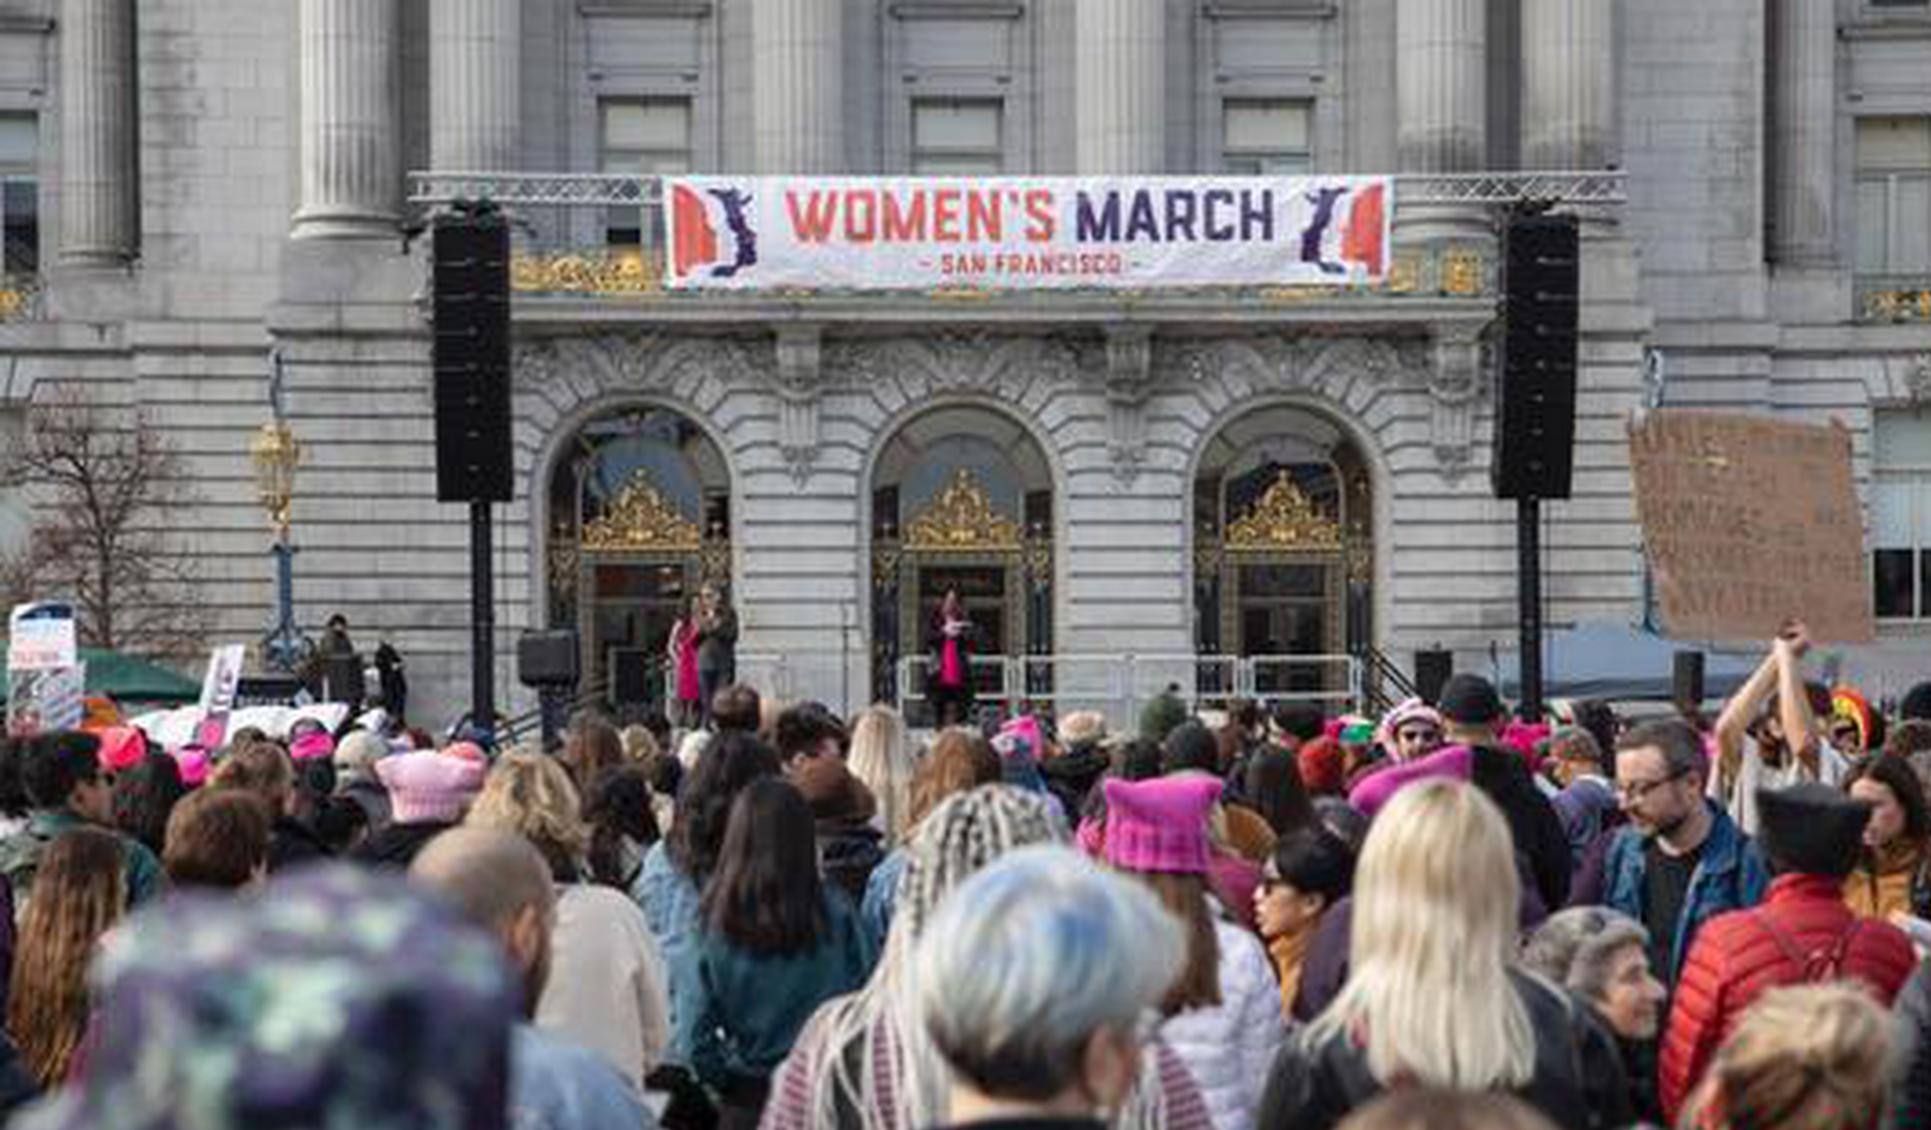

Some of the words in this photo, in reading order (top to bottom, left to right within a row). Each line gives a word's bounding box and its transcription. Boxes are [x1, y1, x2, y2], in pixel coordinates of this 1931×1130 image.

[785, 189, 1054, 243] WOMEN'S
[1076, 189, 1273, 242] MARCH
[941, 254, 986, 274] SAN
[996, 254, 1121, 275] FRANCISCO
